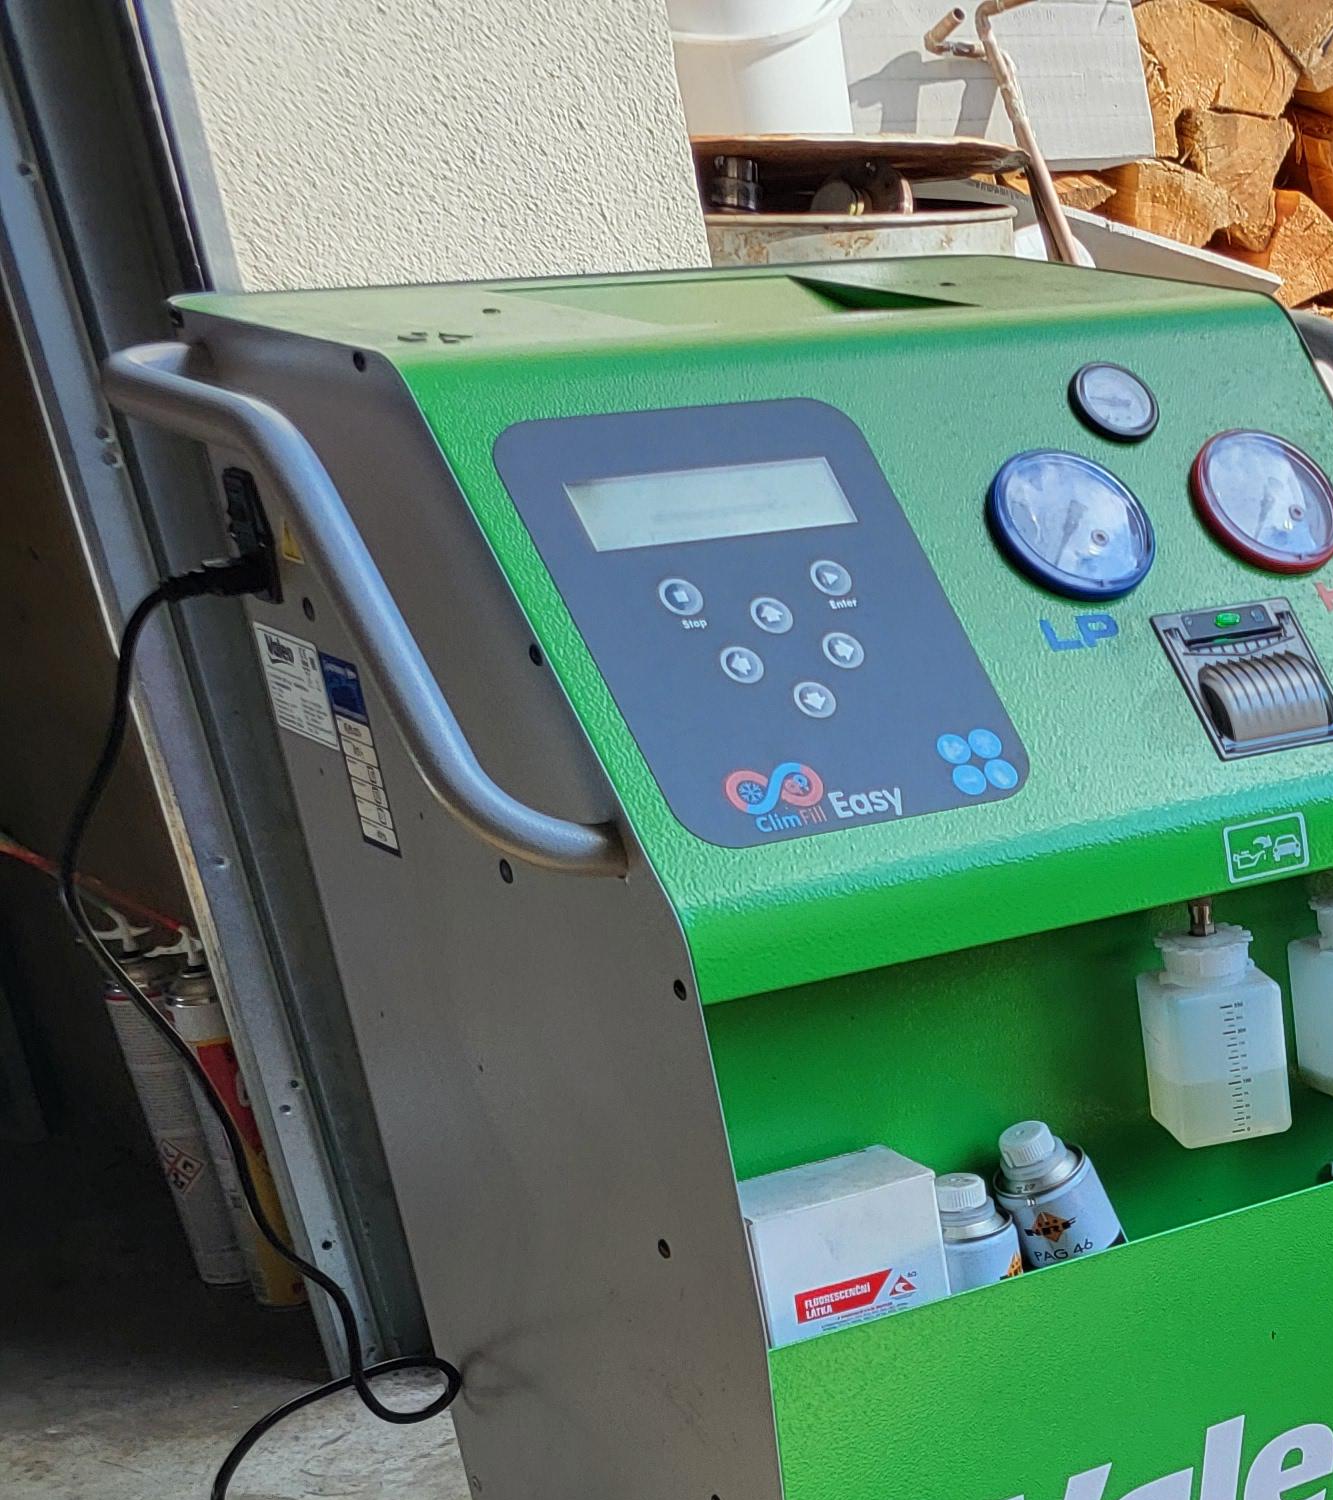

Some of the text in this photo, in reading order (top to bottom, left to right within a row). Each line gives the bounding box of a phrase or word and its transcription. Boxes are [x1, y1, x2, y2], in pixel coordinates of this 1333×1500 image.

[828, 598, 858, 611] Enter
[681, 619, 708, 630] Stop
[1039, 613, 1119, 651] LP
[755, 787, 903, 833] ClimFill Easy
[1034, 1238, 1094, 1261] PAG 46
